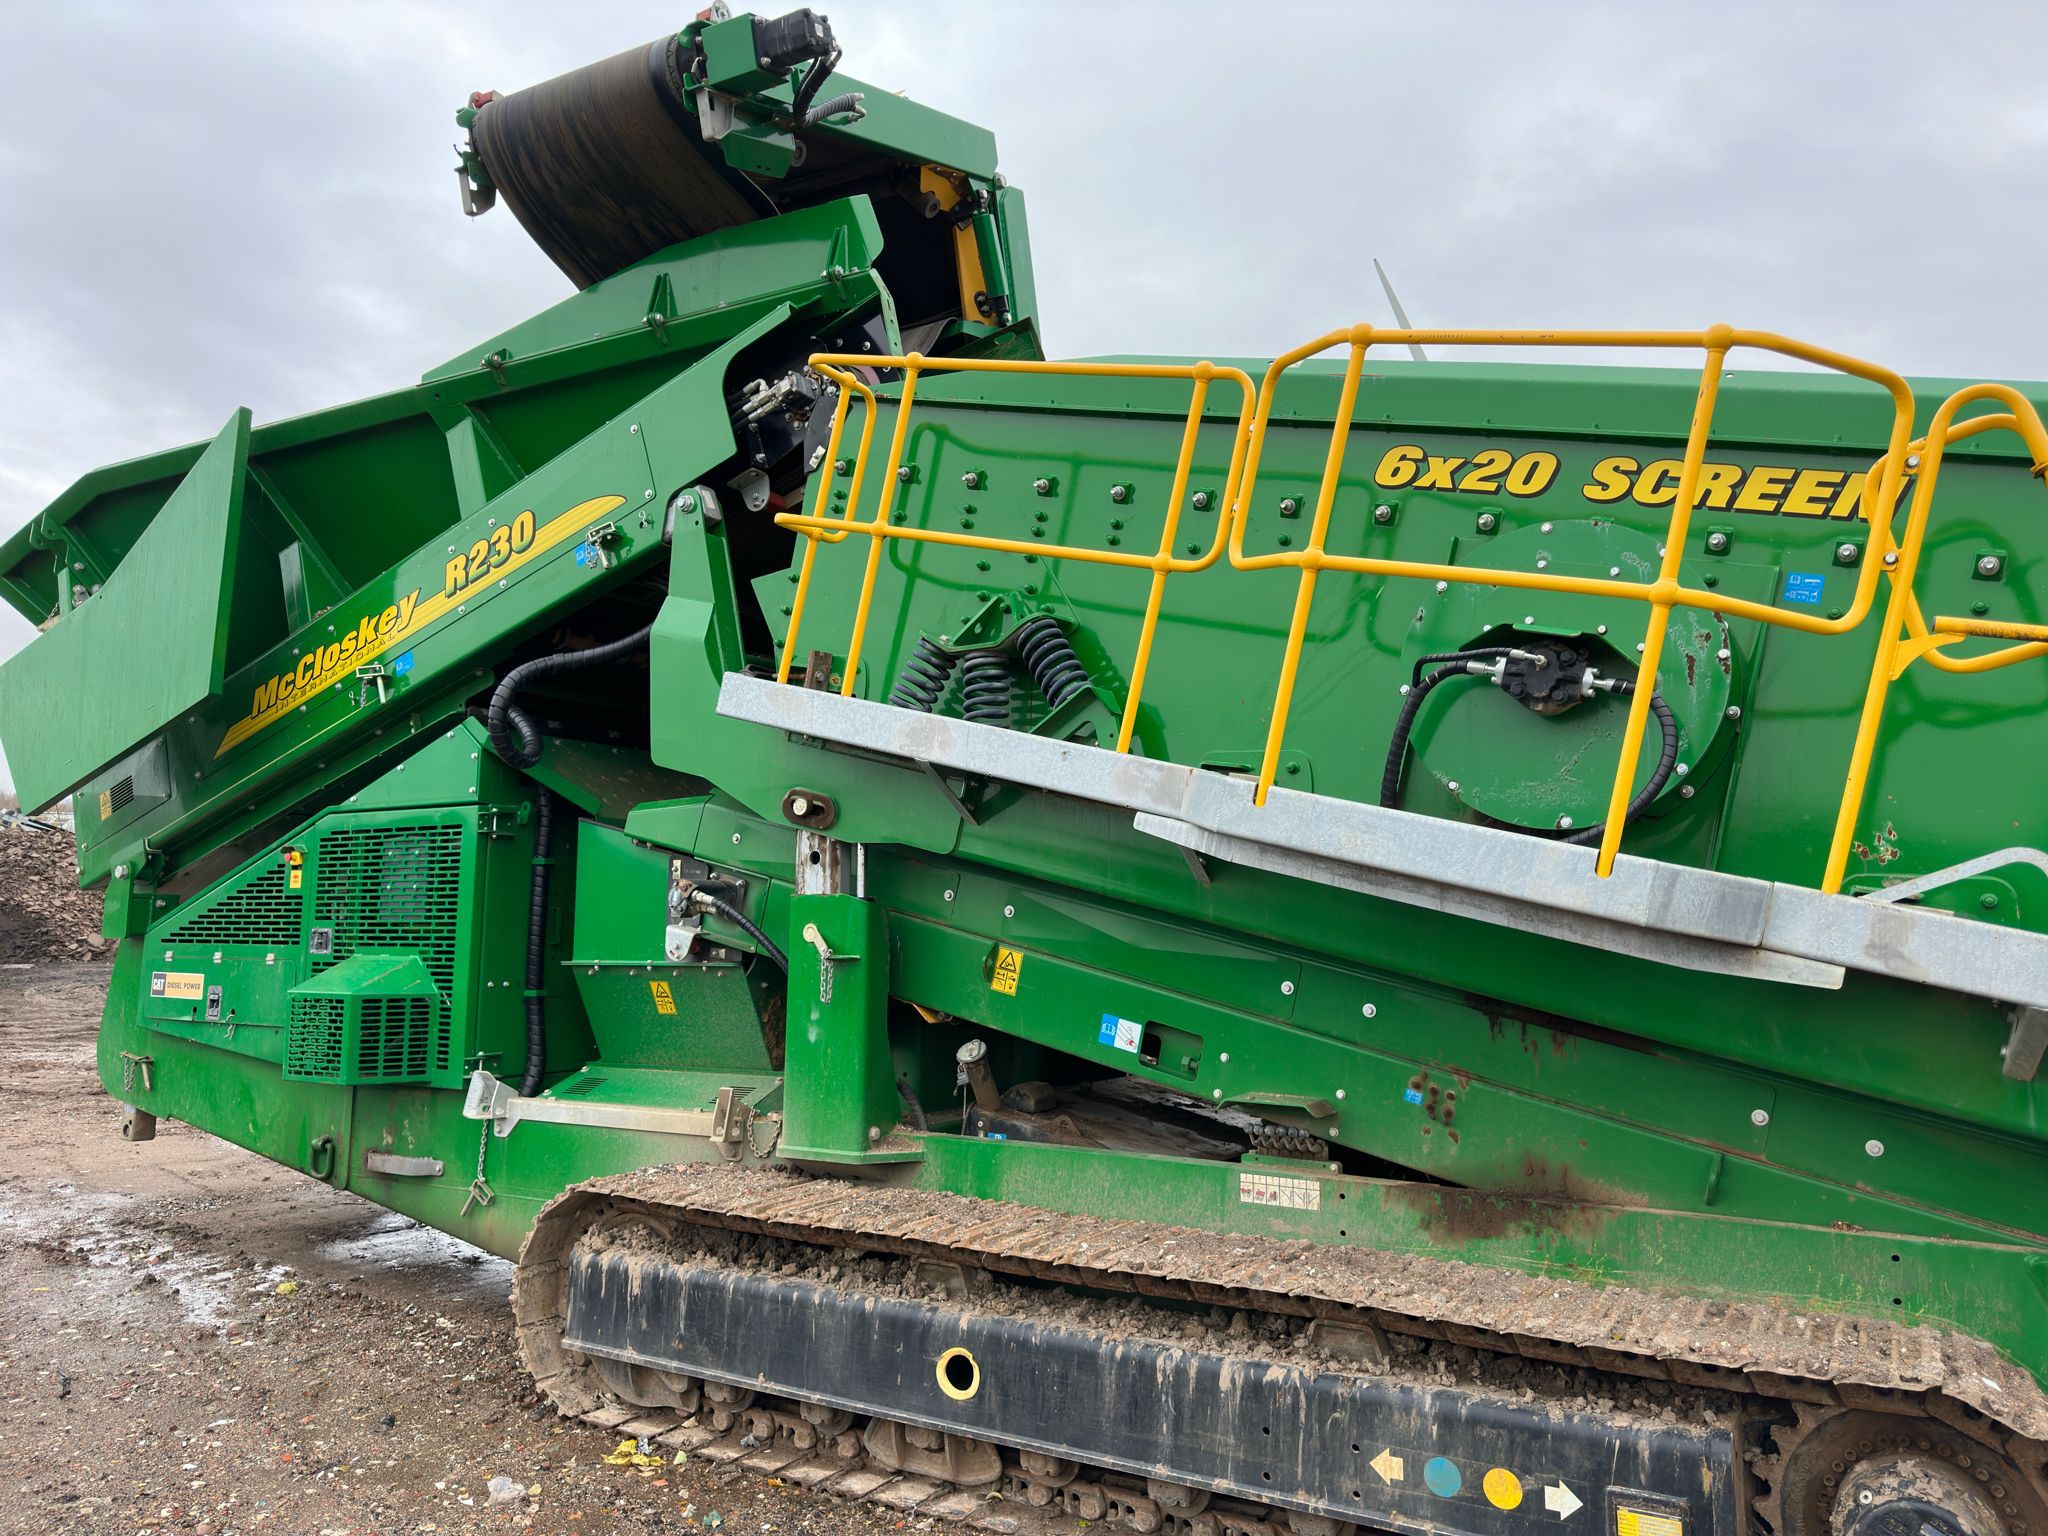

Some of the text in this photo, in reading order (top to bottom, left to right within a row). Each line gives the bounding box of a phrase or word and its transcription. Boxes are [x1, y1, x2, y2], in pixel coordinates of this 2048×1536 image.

[1374, 445, 1561, 498] 6x20
[251, 509, 536, 719] McCloskey R230
[275, 633, 396, 713] INTERNATIONAL
[152, 978, 201, 990] CAT DIESEL POWER
